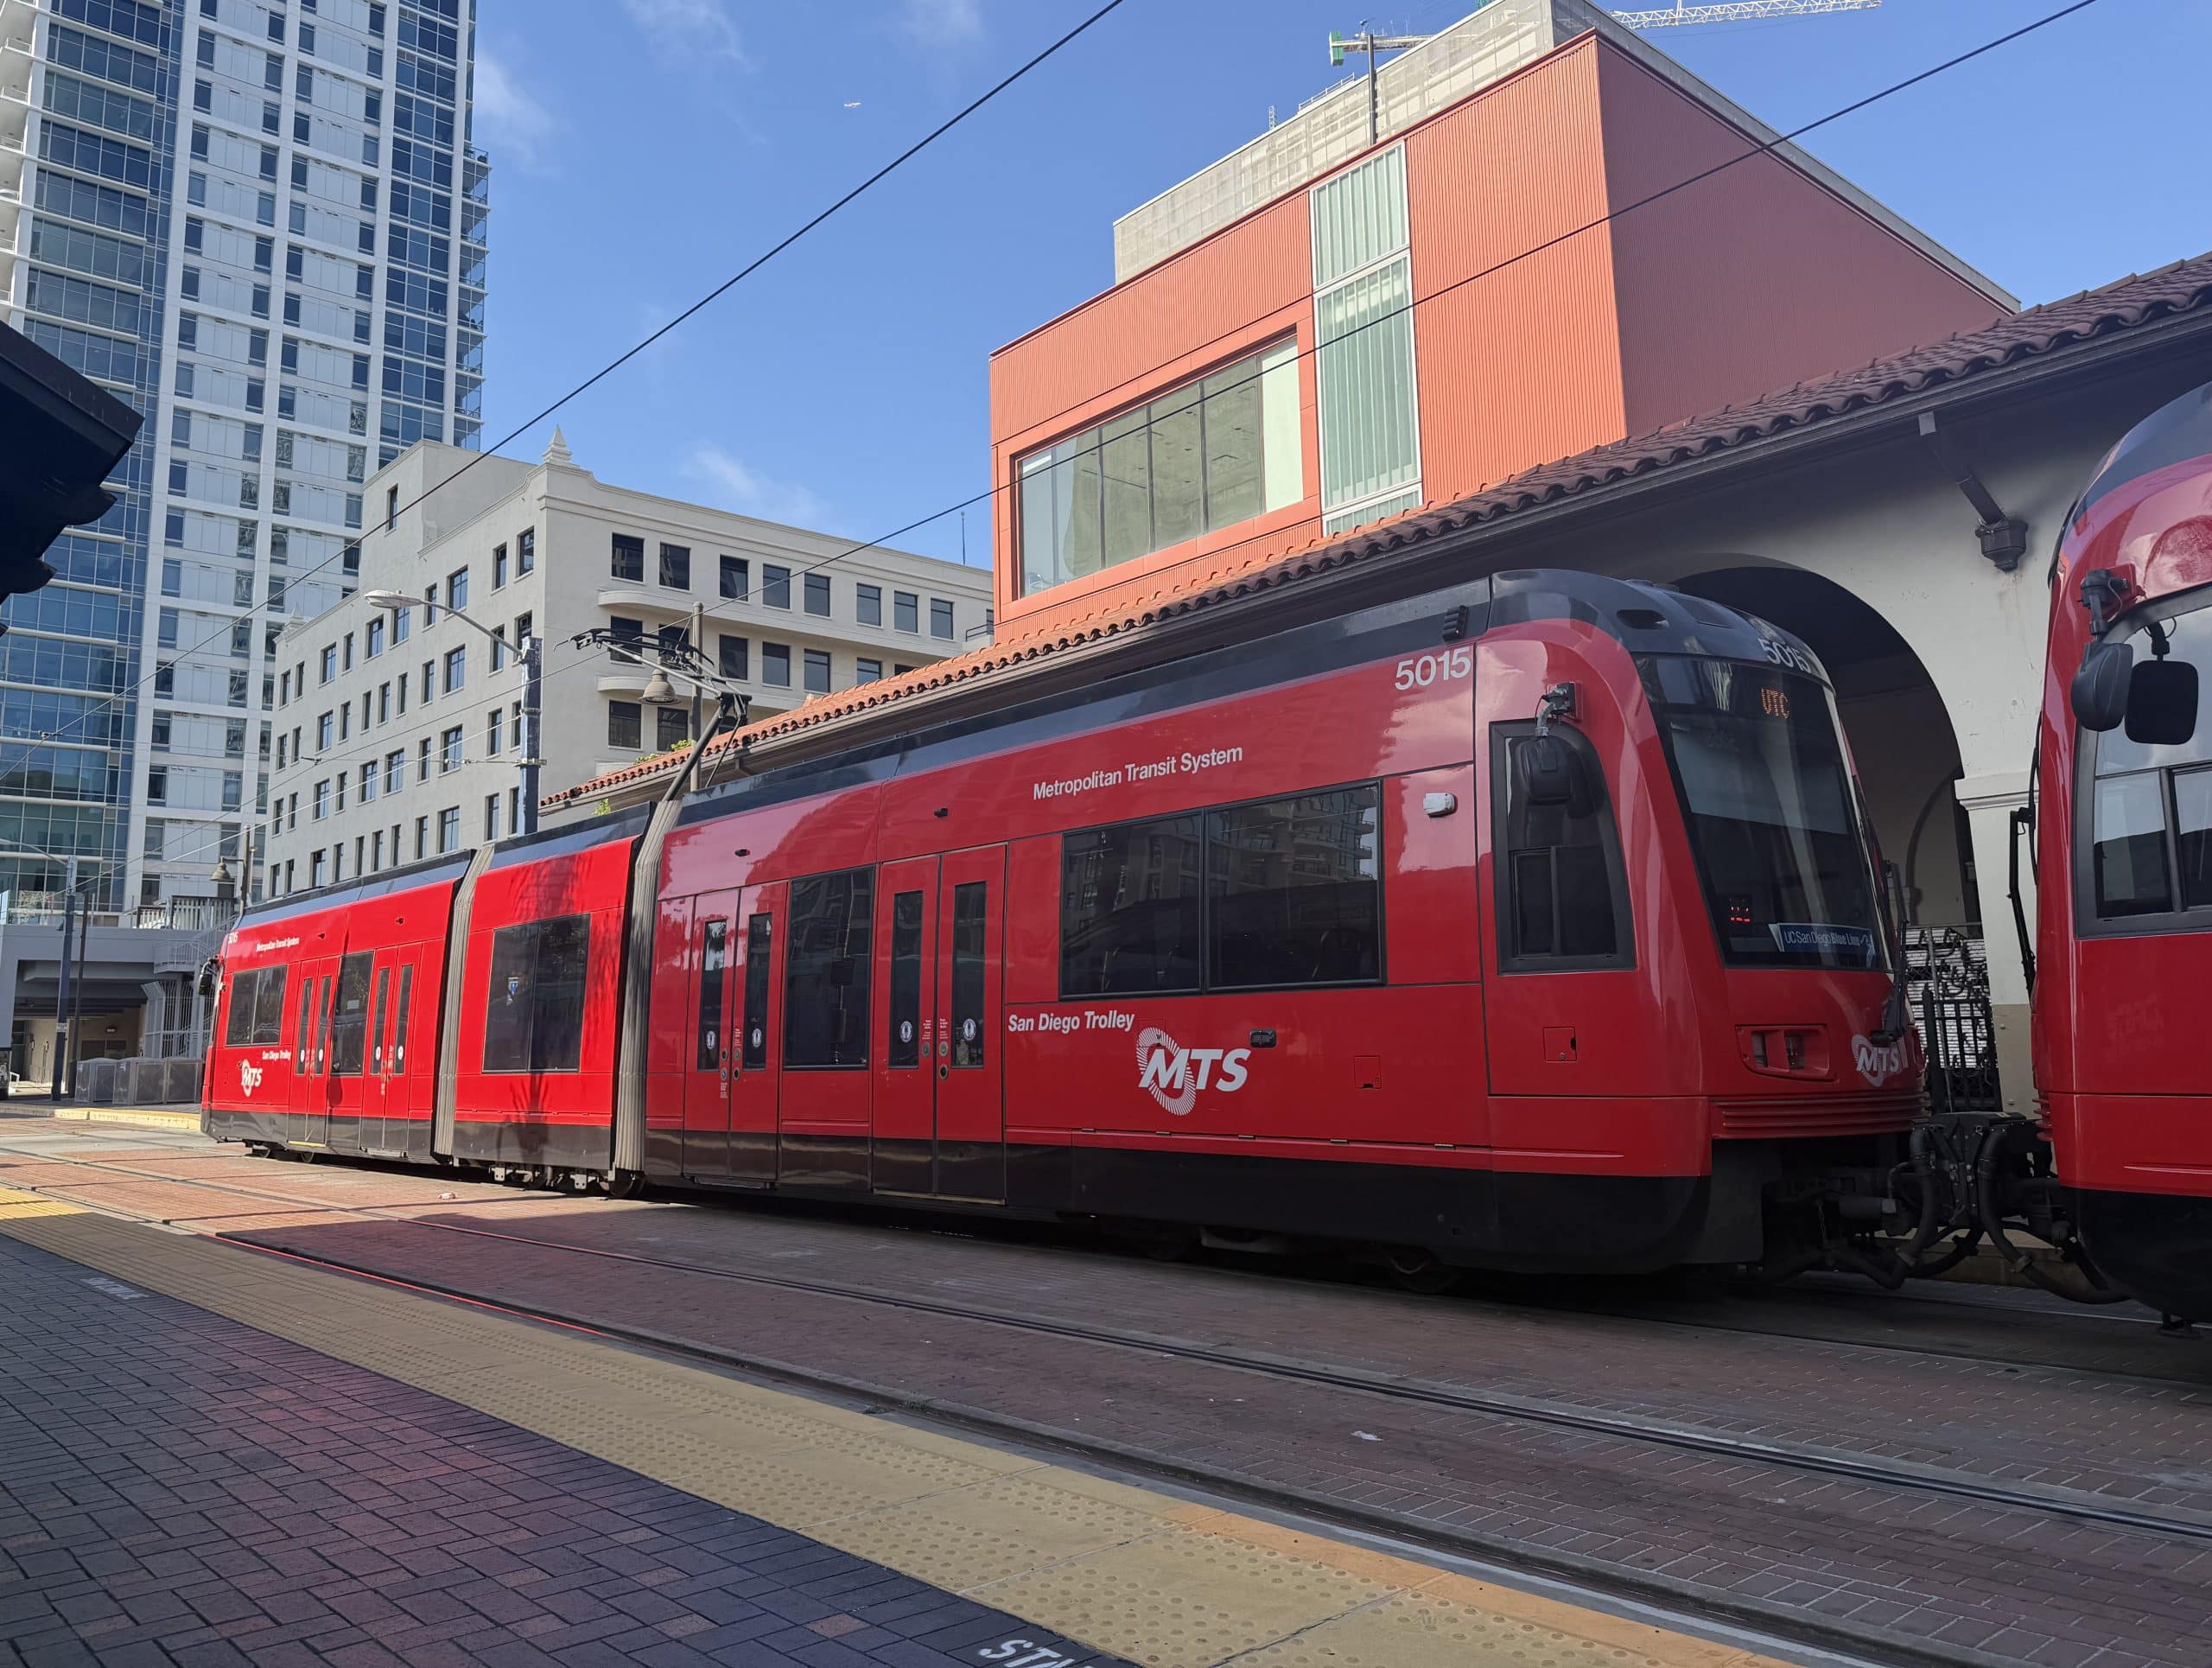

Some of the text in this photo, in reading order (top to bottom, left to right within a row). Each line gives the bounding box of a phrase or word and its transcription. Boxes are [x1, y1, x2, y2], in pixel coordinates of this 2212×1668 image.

[1395, 646, 1471, 691] 5015
[1758, 638, 1812, 674] 5015
[1760, 688, 1789, 719] UTC
[1033, 747, 1243, 800] Metropolitan Transit System
[1783, 931, 1796, 944] UC
[1796, 931, 1811, 945] San
[1811, 932, 1831, 947] Diego
[1008, 1010, 1135, 1035] San Diego Trolley
[1138, 1048, 1252, 1092] MTS
[1856, 1047, 1900, 1074] MTS
[241, 1067, 263, 1087] MTS
